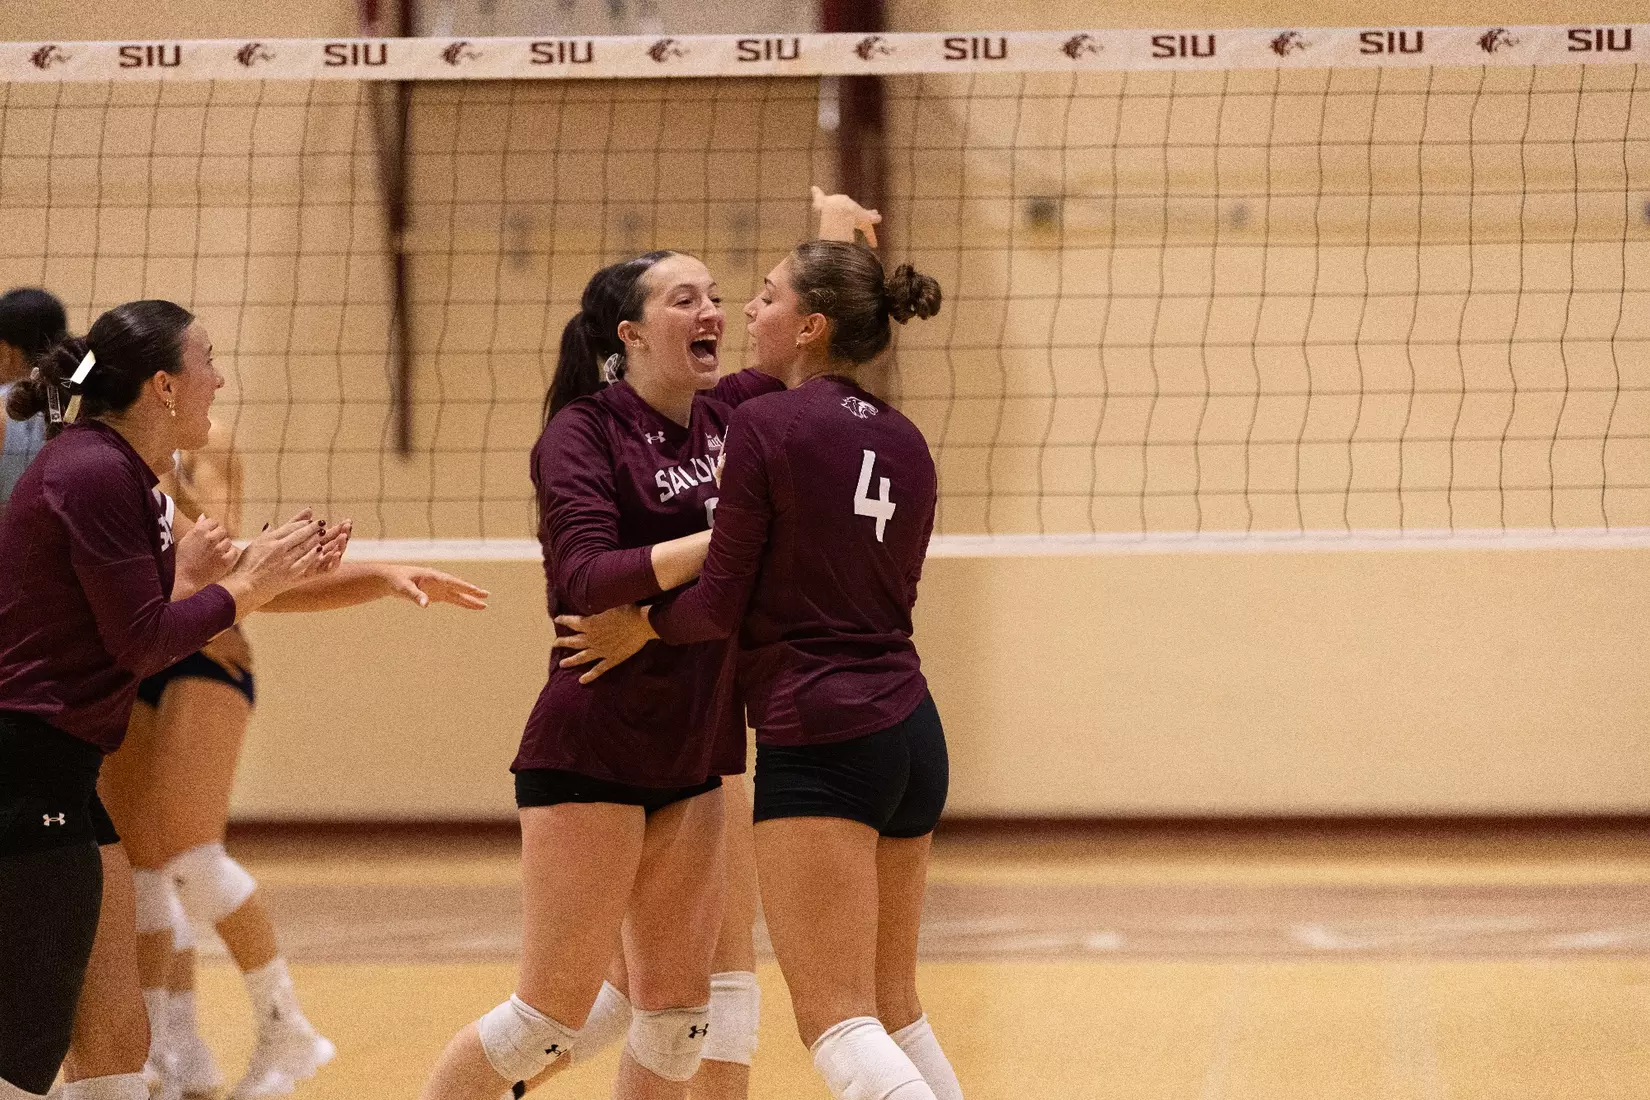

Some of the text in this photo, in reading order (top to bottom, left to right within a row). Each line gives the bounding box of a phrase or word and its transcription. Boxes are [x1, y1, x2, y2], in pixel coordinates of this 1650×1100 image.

[119, 28, 1632, 68] SIU SIU SIU SIU SIU SIU SIU SIU
[854, 449, 897, 542] 4
